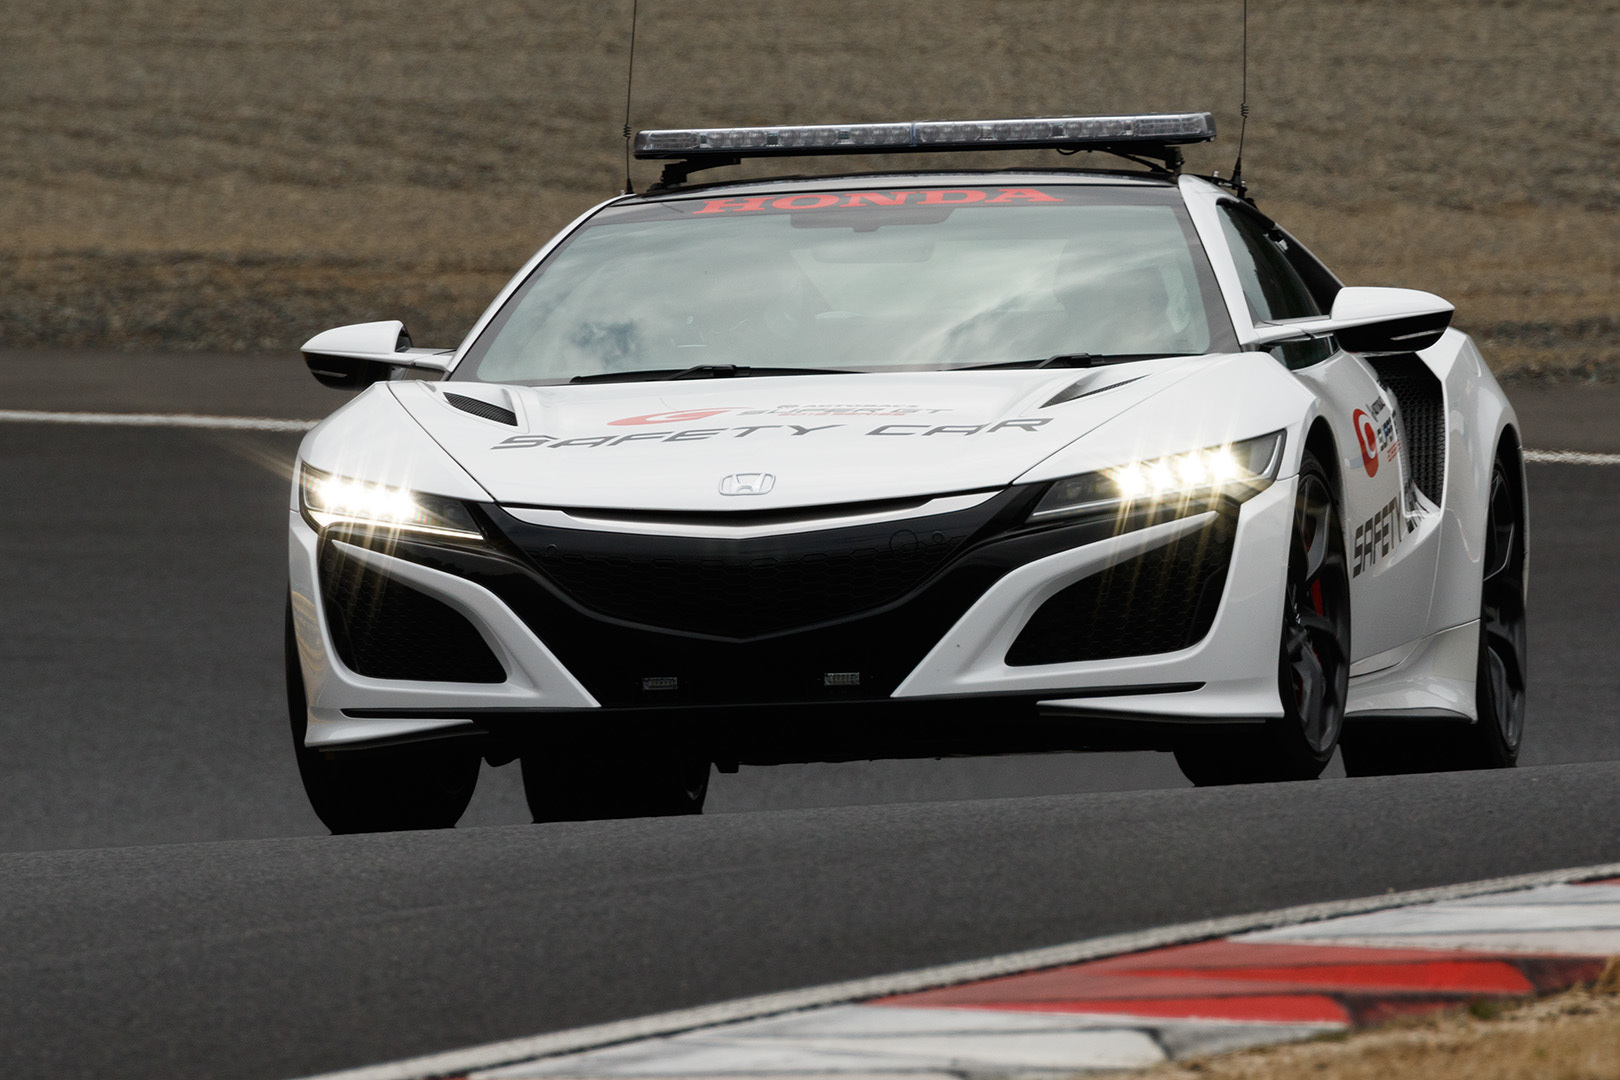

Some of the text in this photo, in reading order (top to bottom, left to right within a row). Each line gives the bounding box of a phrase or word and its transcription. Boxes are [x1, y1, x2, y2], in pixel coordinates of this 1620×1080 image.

[693, 187, 1064, 214] HONDA
[490, 417, 1053, 449] SAFETY CAR
[1352, 489, 1402, 579] SAFETY
